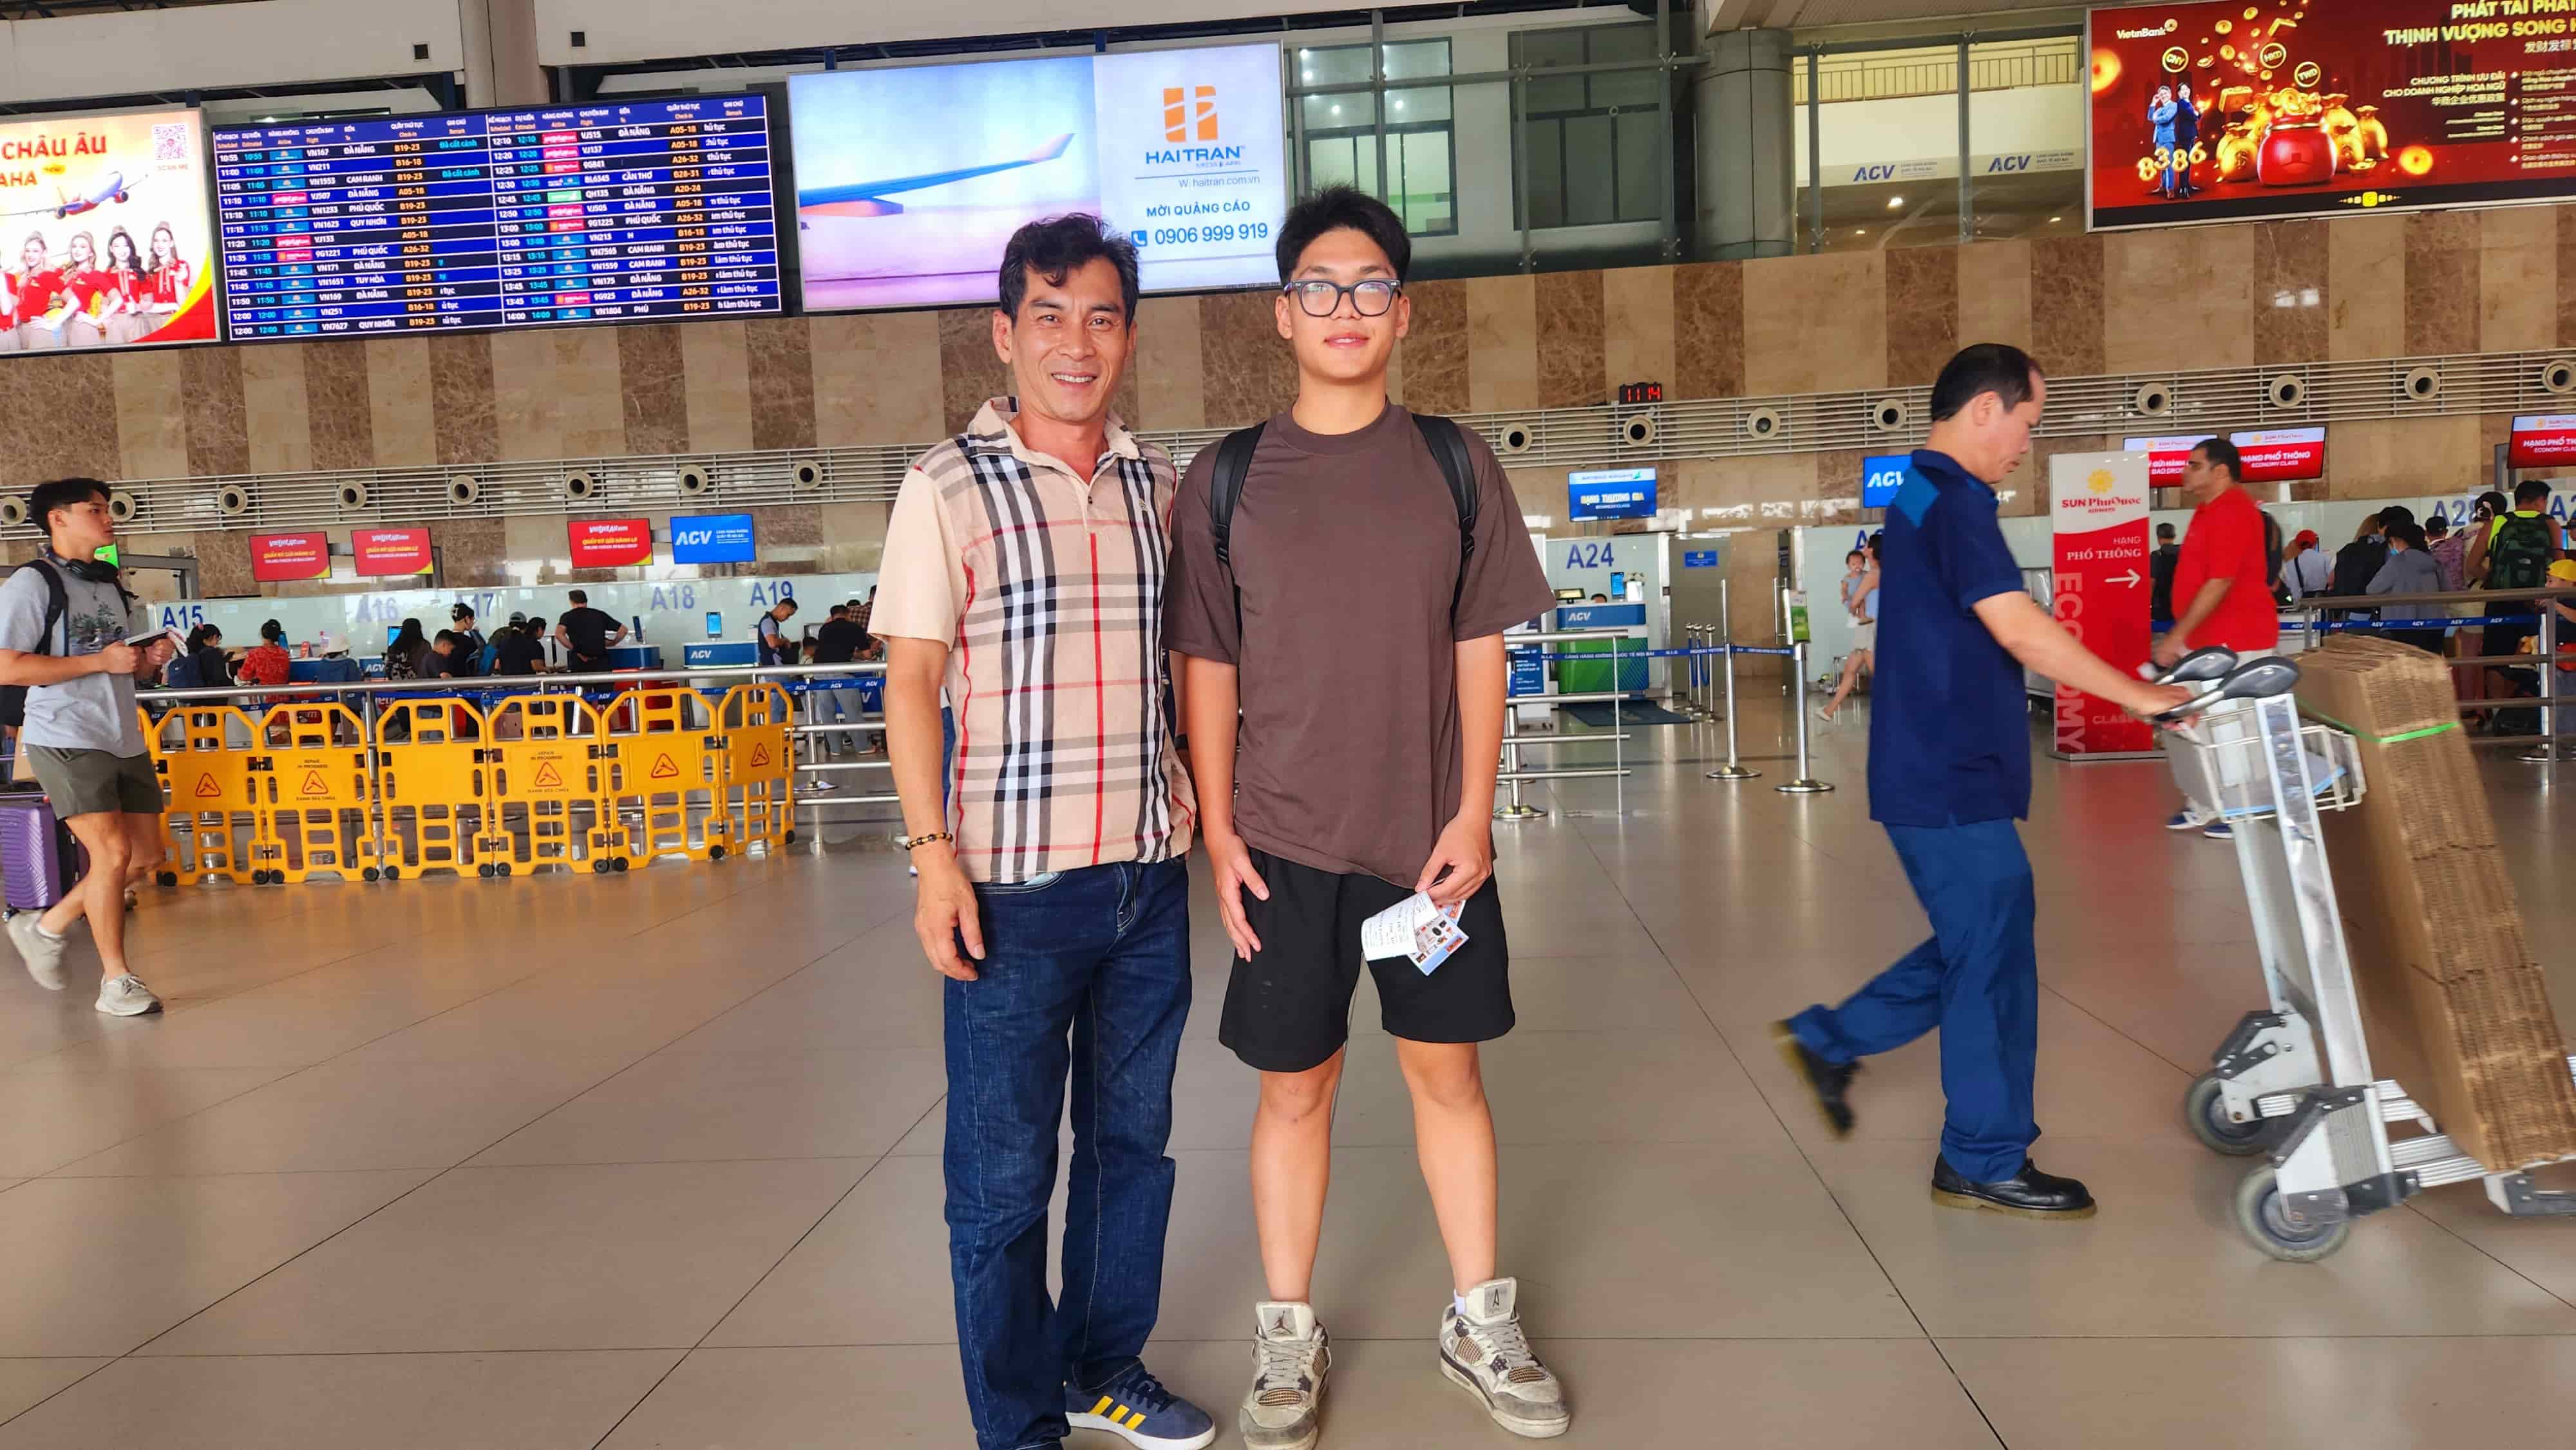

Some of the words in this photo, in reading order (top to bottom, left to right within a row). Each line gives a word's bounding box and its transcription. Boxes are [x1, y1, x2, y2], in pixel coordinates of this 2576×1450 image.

[2116, 27, 2166, 39] VietinBank
[2383, 26, 2438, 47] THỊNH
[2441, 23, 2510, 43] VƯỢNG
[2512, 19, 2566, 37] SONG
[2165, 53, 2185, 66] CNY
[2297, 68, 2318, 80] TWD
[2383, 89, 2403, 97] CHO
[1, 135, 67, 160] CHÂU
[74, 132, 108, 155] ÂU
[1146, 146, 1241, 164] HAITRAN
[1989, 155, 2031, 172] ACV
[2137, 141, 2207, 181] 8386
[1193, 174, 1260, 188] haitran.com.vn
[1854, 165, 1895, 182] ACV
[1146, 203, 1171, 217] MỜI
[1174, 202, 1220, 216] QUẢNG
[1224, 198, 1251, 212] CÁO
[1155, 227, 1198, 245] 0906
[1202, 225, 1235, 241] 999
[1238, 223, 1268, 240] 919
[2062, 499, 2086, 508] SUN
[676, 531, 712, 546] ACV
[1566, 542, 1615, 569] A24
[2067, 547, 2093, 561] PHỔ
[2096, 547, 2141, 560] THÔNG
[650, 585, 696, 611] A18
[750, 581, 793, 607] A19
[162, 605, 204, 630] A15
[355, 596, 399, 623] A16
[1568, 612, 1591, 621] ACV
[691, 650, 712, 659] ACV
